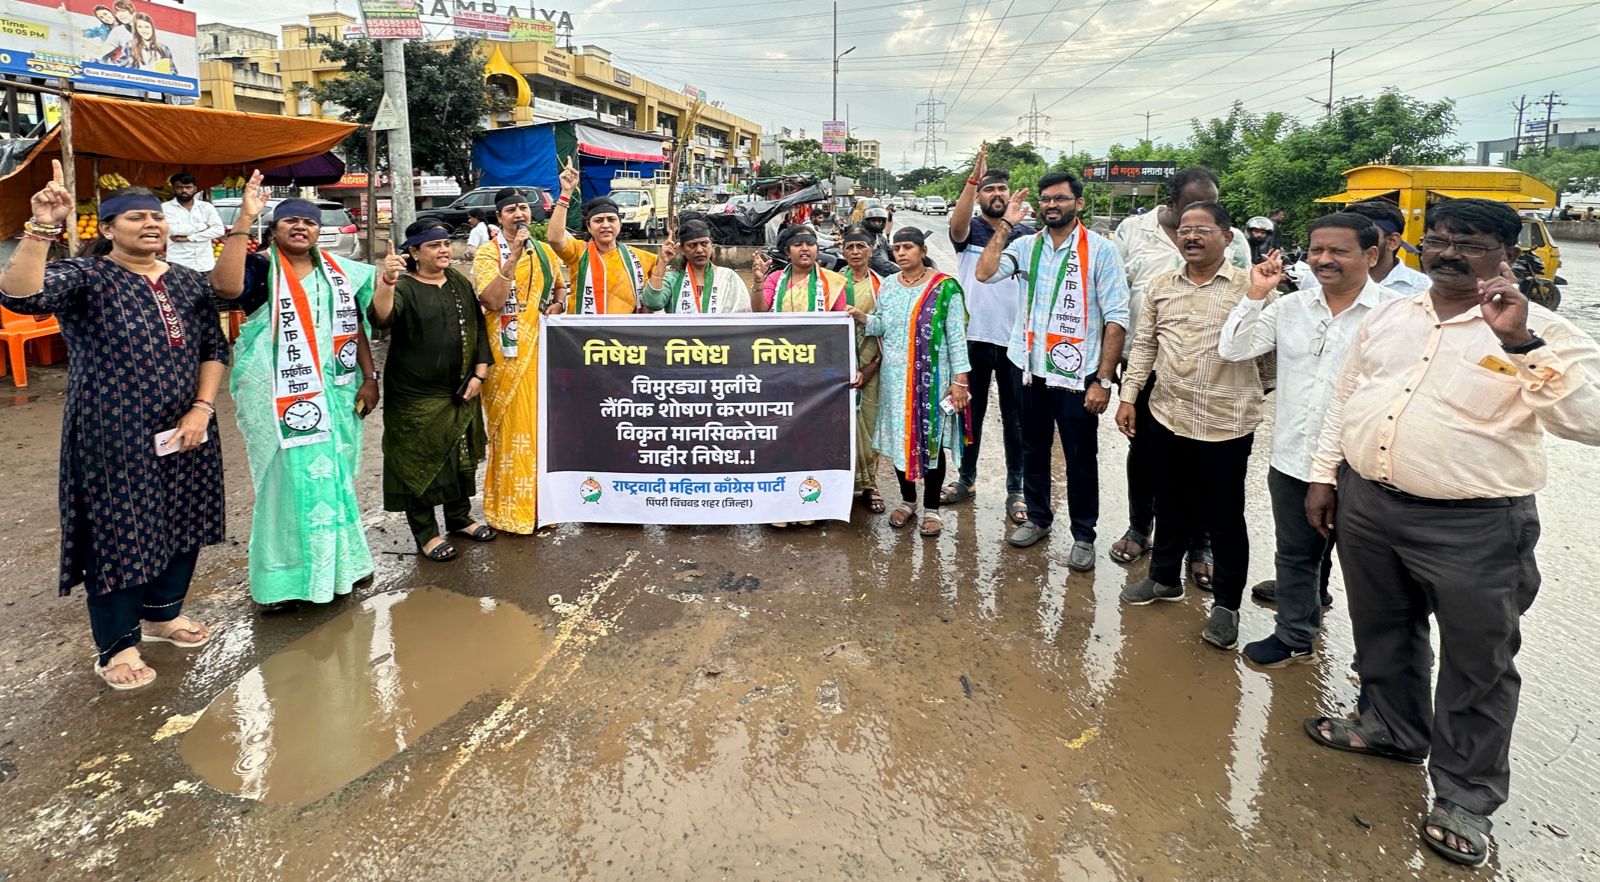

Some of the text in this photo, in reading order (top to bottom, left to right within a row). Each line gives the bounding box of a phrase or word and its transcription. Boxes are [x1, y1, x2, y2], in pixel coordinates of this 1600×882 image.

[30, 30, 45, 39] PM
[583, 337, 817, 366] निषेध निषेध निषेध
[631, 373, 762, 401] चिमुरड्या मुलीचे
[600, 396, 654, 418] लैंगिक
[658, 397, 712, 418] शोषण
[616, 420, 778, 447] विकृत मानसिकतेचा
[638, 446, 756, 467] जाहीर निषेध..!
[612, 476, 787, 497] राष्ट्रवादी महिला काँग्रेस पार्टी
[645, 497, 753, 509] पिंपरी चिंचवड शहर (जिल्हा)
